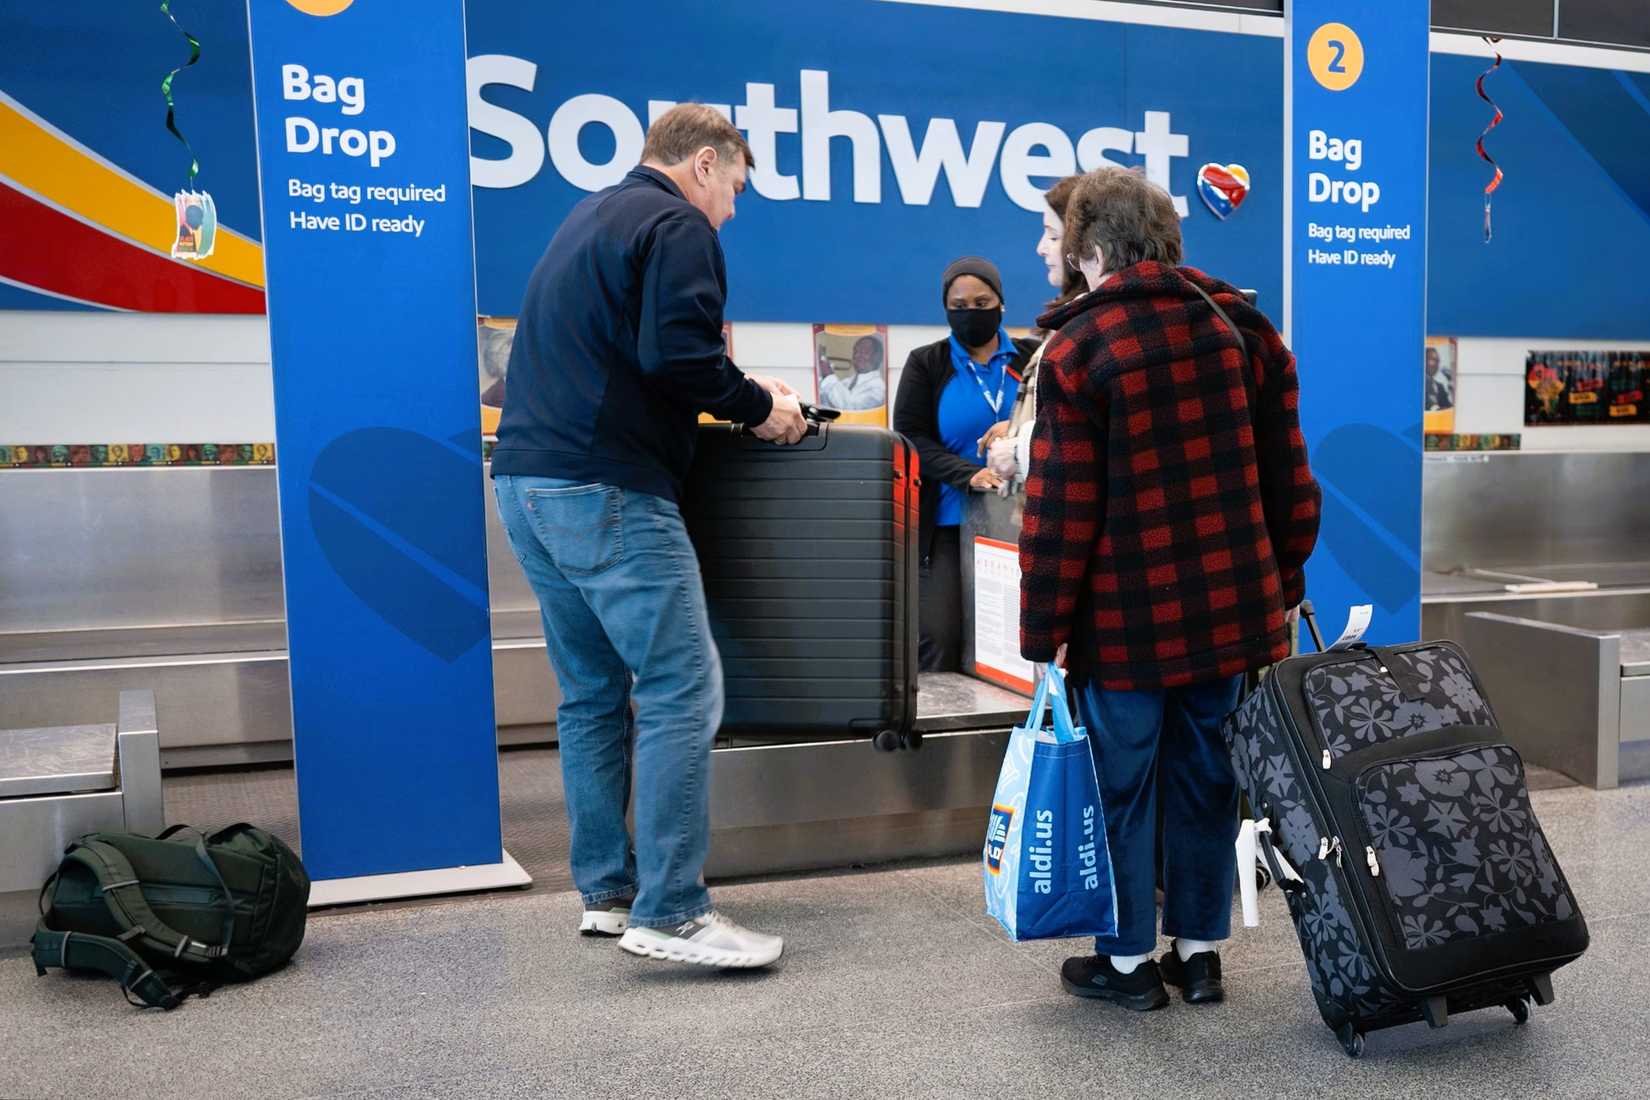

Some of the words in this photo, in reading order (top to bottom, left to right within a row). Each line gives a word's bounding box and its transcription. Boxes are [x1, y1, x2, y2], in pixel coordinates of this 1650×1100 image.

[1327, 40, 1346, 73] 2
[282, 64, 365, 115] Bag
[285, 117, 396, 167] Drop
[466, 54, 1190, 218] Sothwest
[1308, 129, 1362, 171] Bag
[288, 178, 326, 203] Bag
[330, 182, 362, 204] tag
[366, 183, 447, 206] required
[1308, 172, 1380, 213] Drop
[289, 210, 341, 231] Have
[345, 213, 367, 232] ID
[371, 214, 425, 238] ready
[1308, 222, 1333, 242] Bag
[1335, 224, 1356, 243] tag
[1358, 224, 1411, 243] required
[1308, 249, 1342, 264] Have
[1343, 249, 1359, 265] ID
[1360, 249, 1397, 269] ready
[1029, 809, 1053, 895] aldi.us
[1077, 804, 1099, 891] aldi.us
